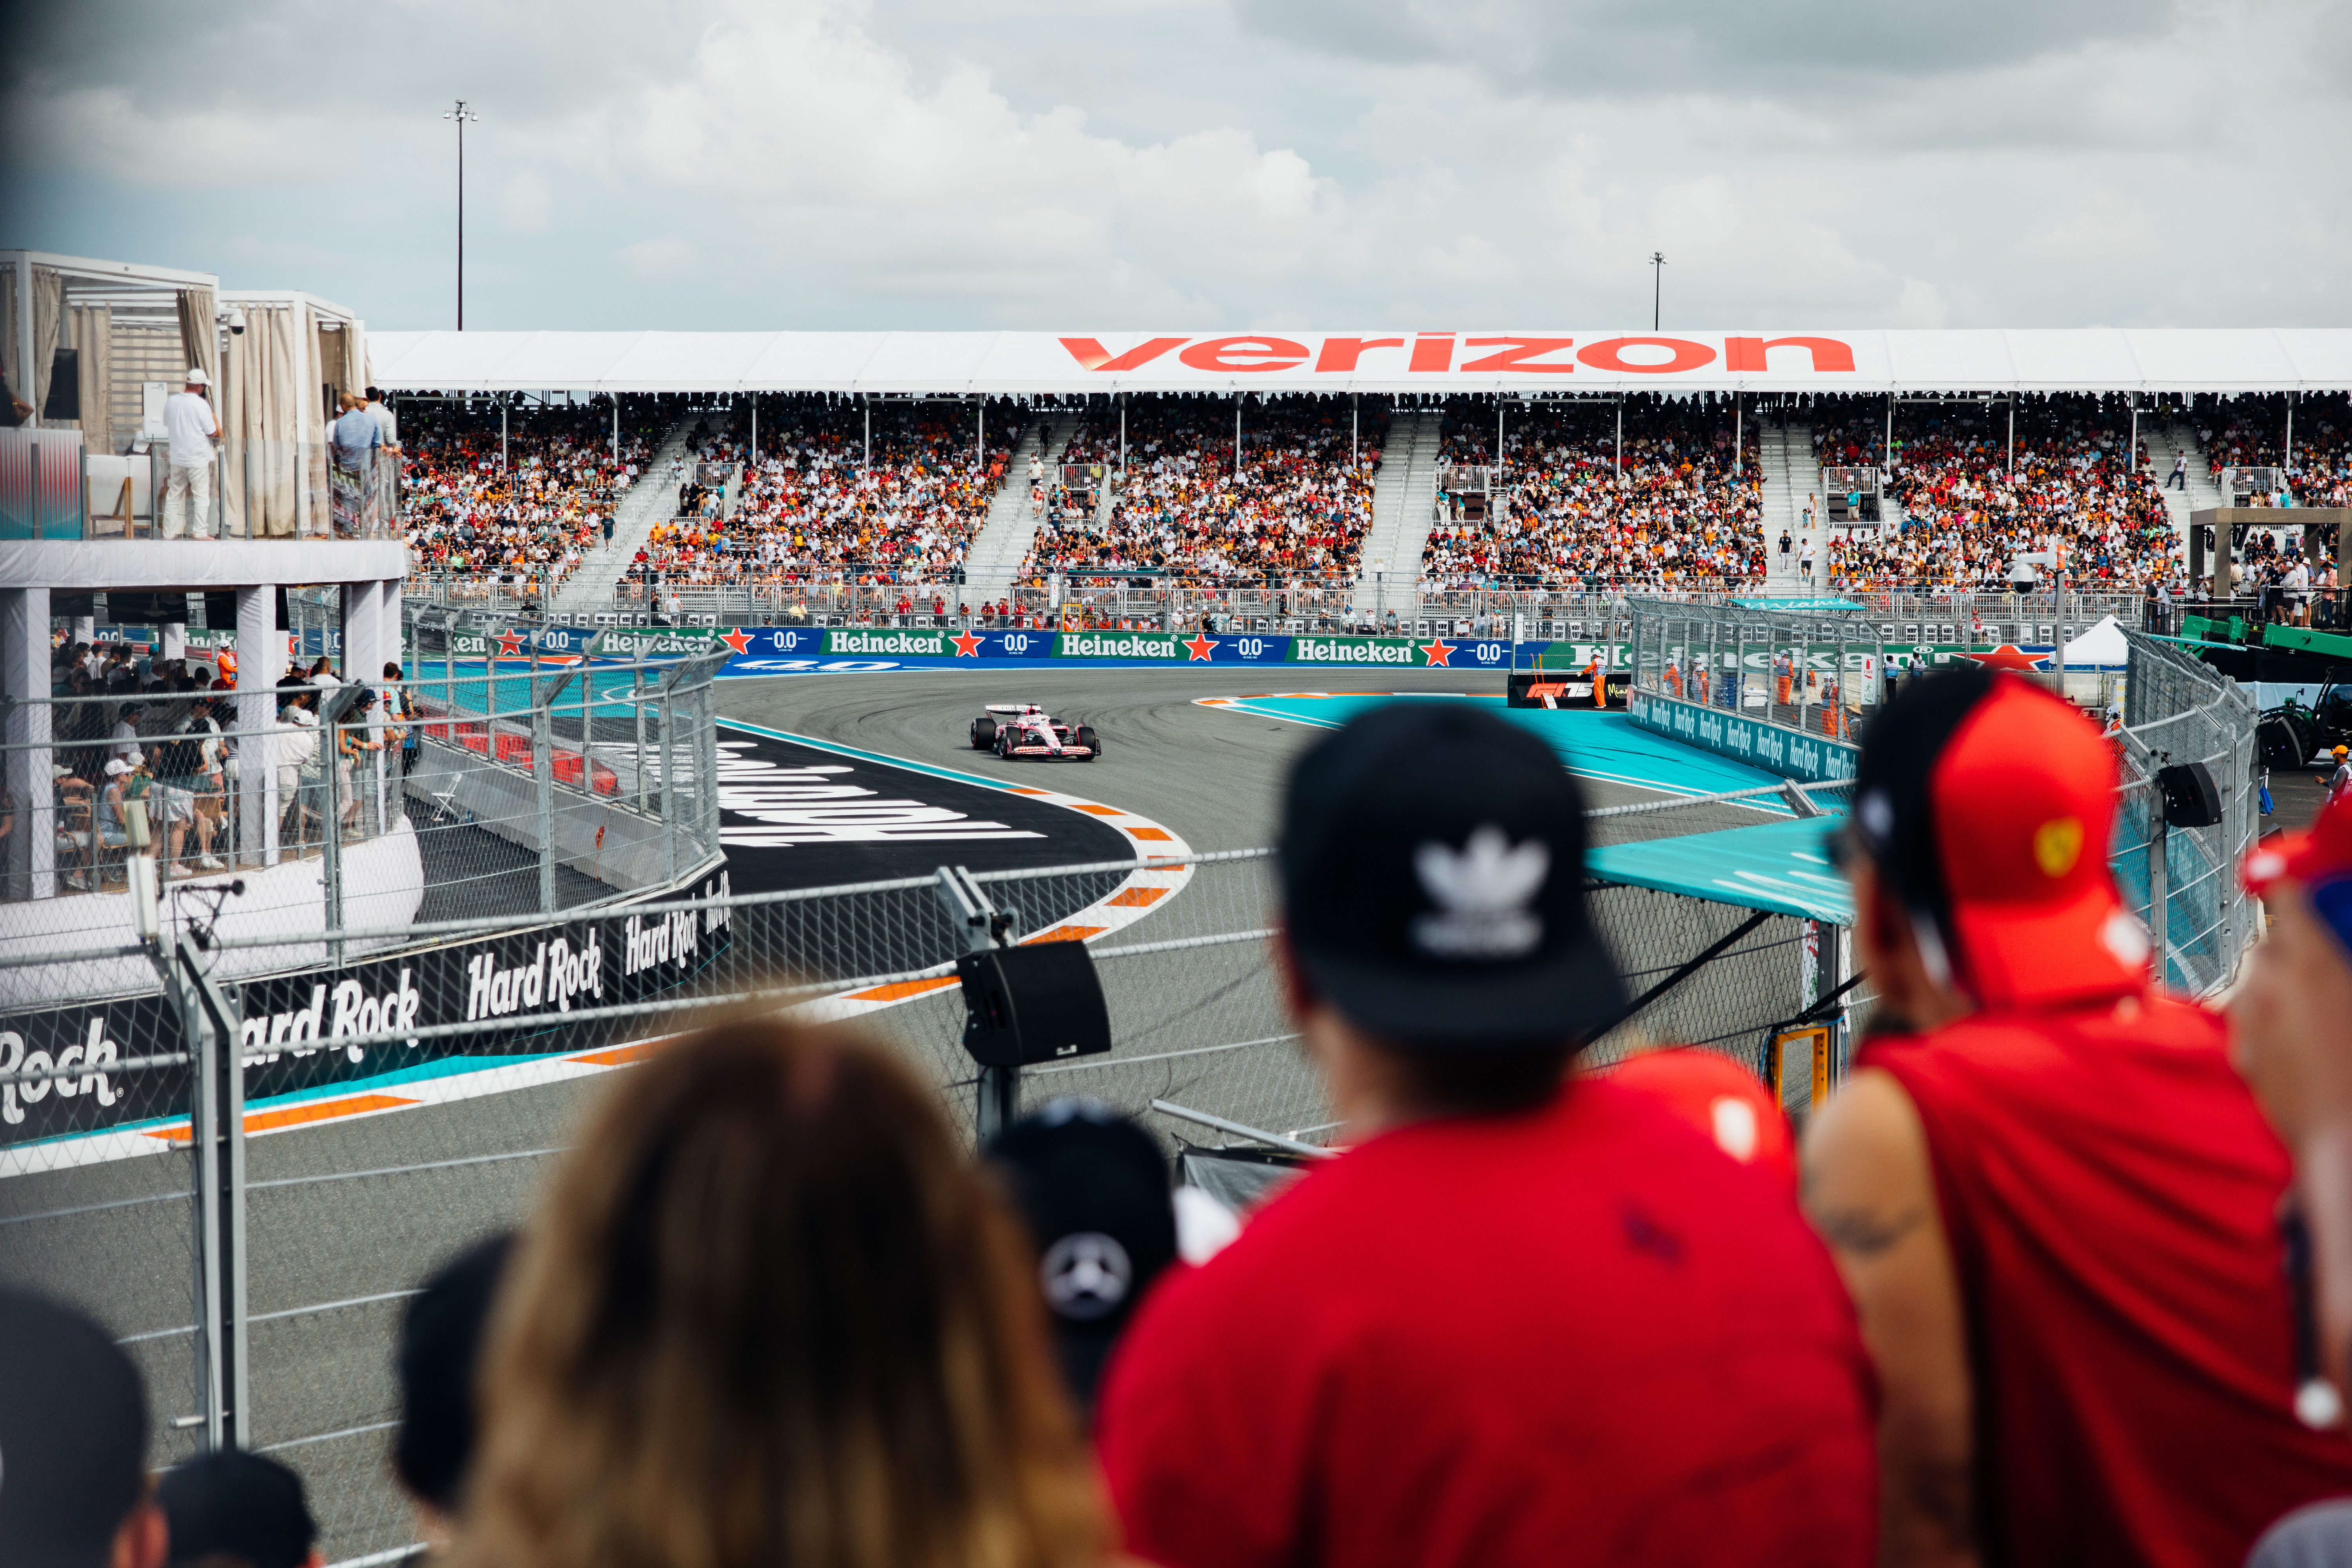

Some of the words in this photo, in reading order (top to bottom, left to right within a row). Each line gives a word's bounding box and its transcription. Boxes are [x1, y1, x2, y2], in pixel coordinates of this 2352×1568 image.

[1057, 332, 1855, 373] verizon
[546, 632, 568, 648] 0.0
[774, 632, 797, 648] 0.0
[831, 632, 943, 654] Heineken
[1005, 634, 1027, 651] 0.0
[1062, 635, 1176, 657] Heineken
[1239, 638, 1262, 655] 0.0
[1297, 639, 1413, 662] Heineken
[1477, 644, 1500, 661] 0.0
[1652, 699, 1662, 724] Hard
[1661, 701, 1670, 732] Rock
[1675, 705, 1686, 731] Hard
[1685, 708, 1695, 739] Rock
[1700, 712, 1711, 739] Hard
[1711, 714, 1721, 748] Rock
[1727, 720, 1740, 748] Hard
[1739, 722, 1751, 757] Rock
[1757, 726, 1771, 757] Hard
[1770, 731, 1783, 768] Rock
[1790, 736, 1805, 768] Hard
[1804, 740, 1818, 779] Rock
[1826, 746, 1842, 779] Hard
[1842, 751, 1856, 780] Rock
[626, 912, 670, 976] Hard
[672, 893, 697, 969] Rock
[468, 942, 546, 1021] Hard
[548, 927, 601, 1013] Rock
[241, 985, 326, 1068] ard
[330, 969, 419, 1063] Rock
[0, 1018, 117, 1124] Rock
